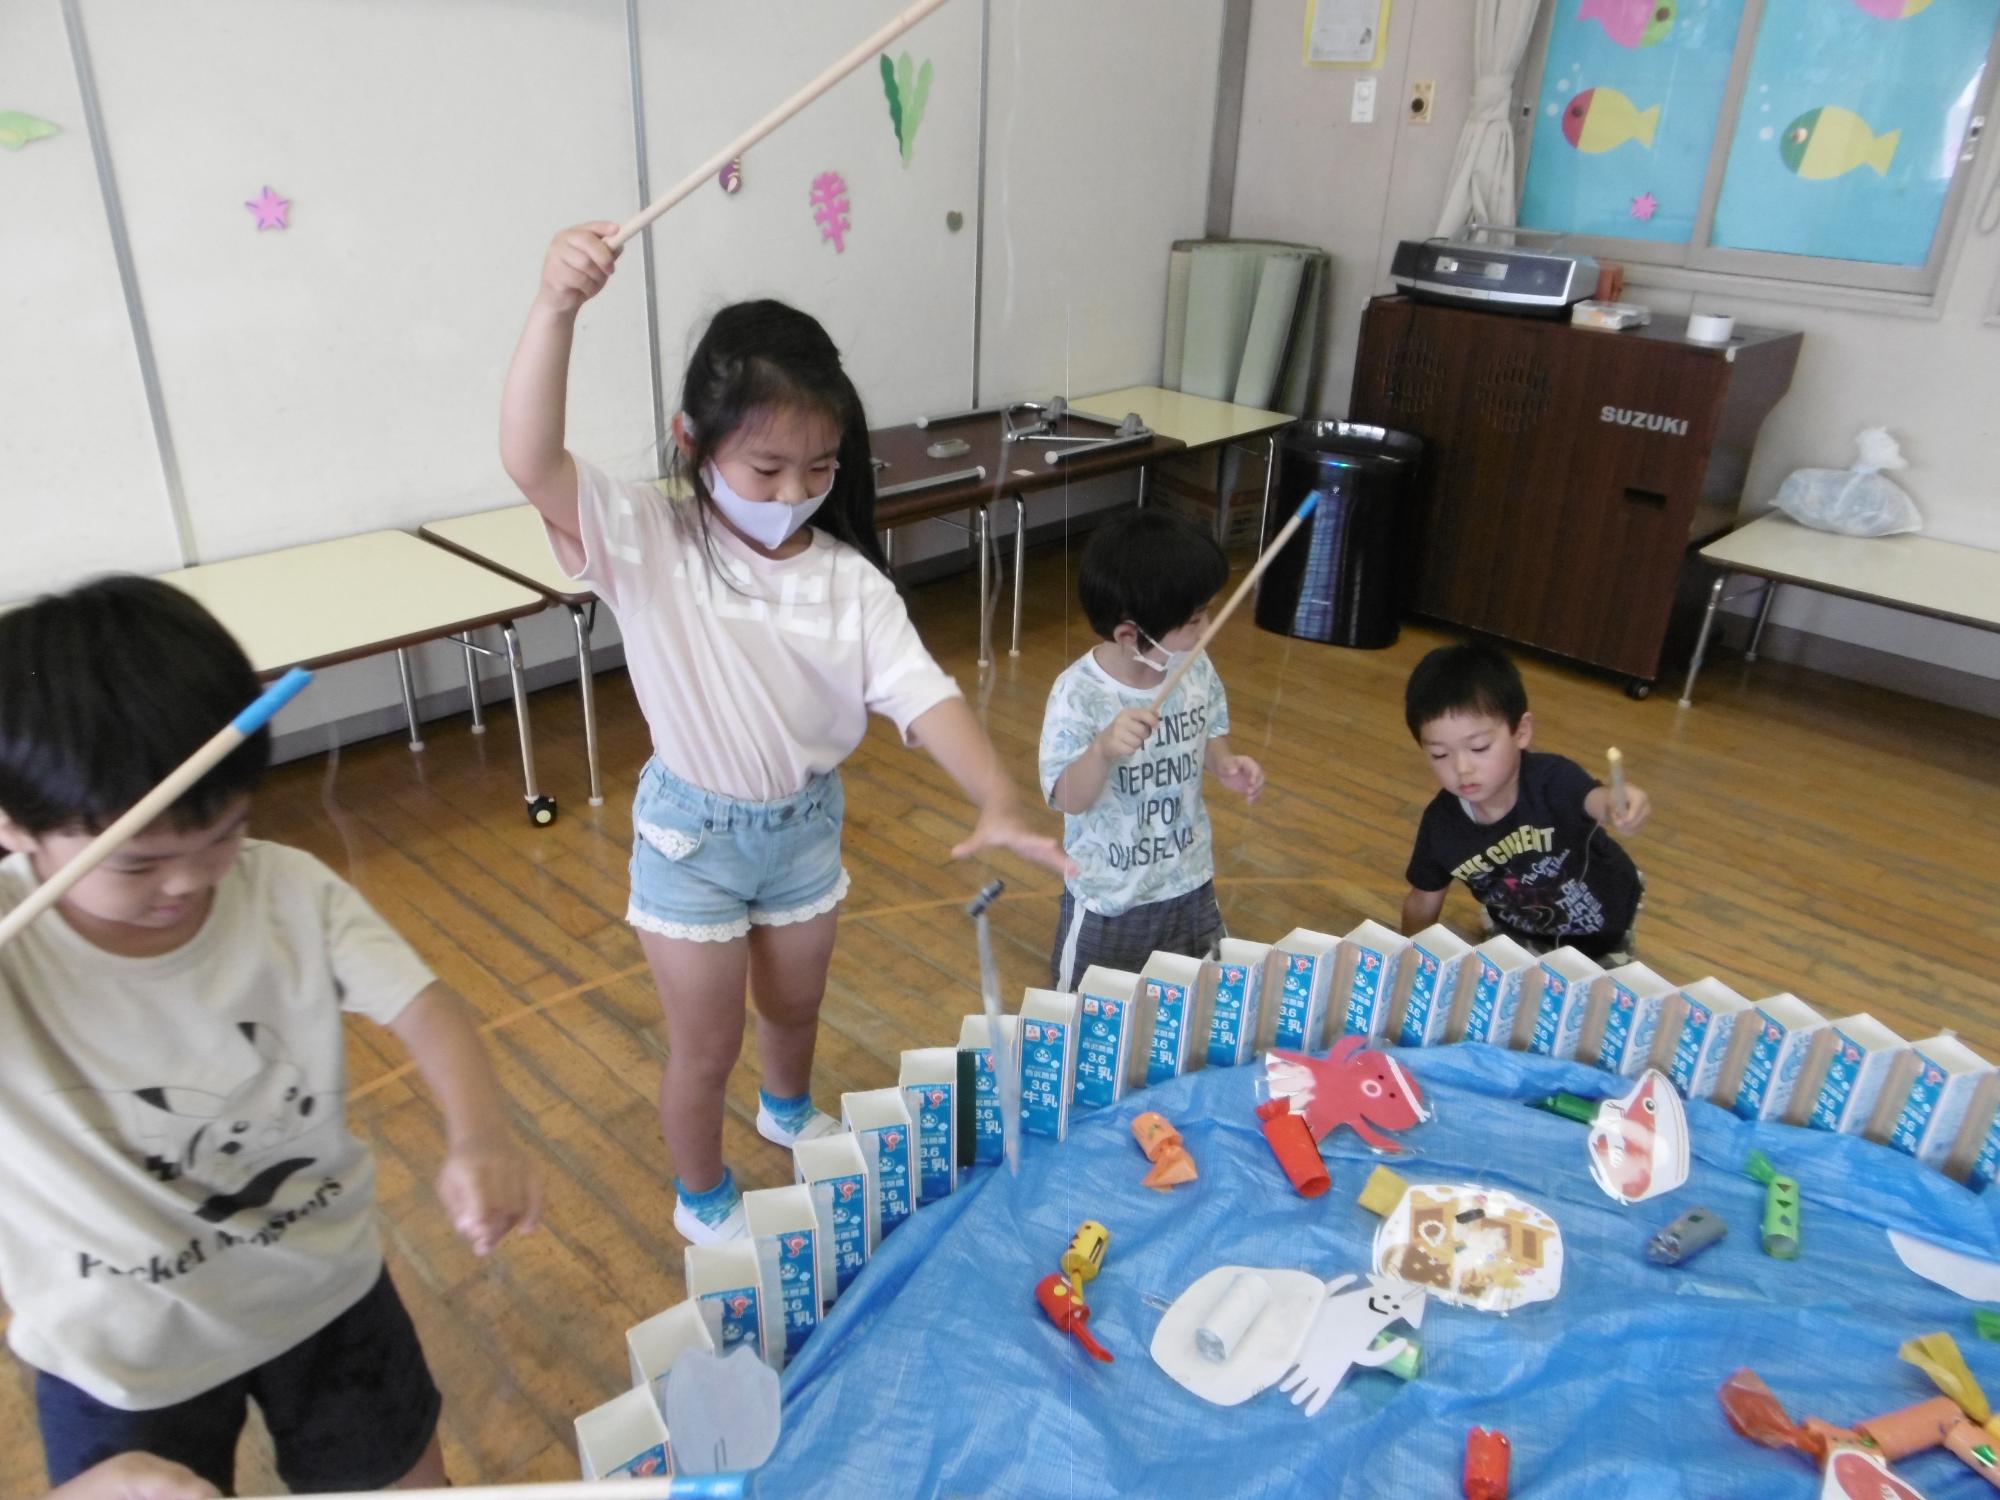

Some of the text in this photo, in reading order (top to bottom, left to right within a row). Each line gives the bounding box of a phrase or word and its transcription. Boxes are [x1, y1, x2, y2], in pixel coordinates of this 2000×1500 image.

[1600, 406, 1688, 436] SUZUKI
[1118, 749, 1198, 796] DEPENDS
[1279, 1006, 1297, 1018] 3.6
[1211, 1019, 1229, 1030] 3.6
[1151, 1038, 1168, 1049] 3.6
[1087, 1052, 1107, 1065] 3.6
[1079, 1062, 1113, 1082] 牛乳
[1031, 1080, 1050, 1091] 3.6
[1023, 1090, 1058, 1108] 牛乳
[975, 1109, 993, 1119] 3.6
